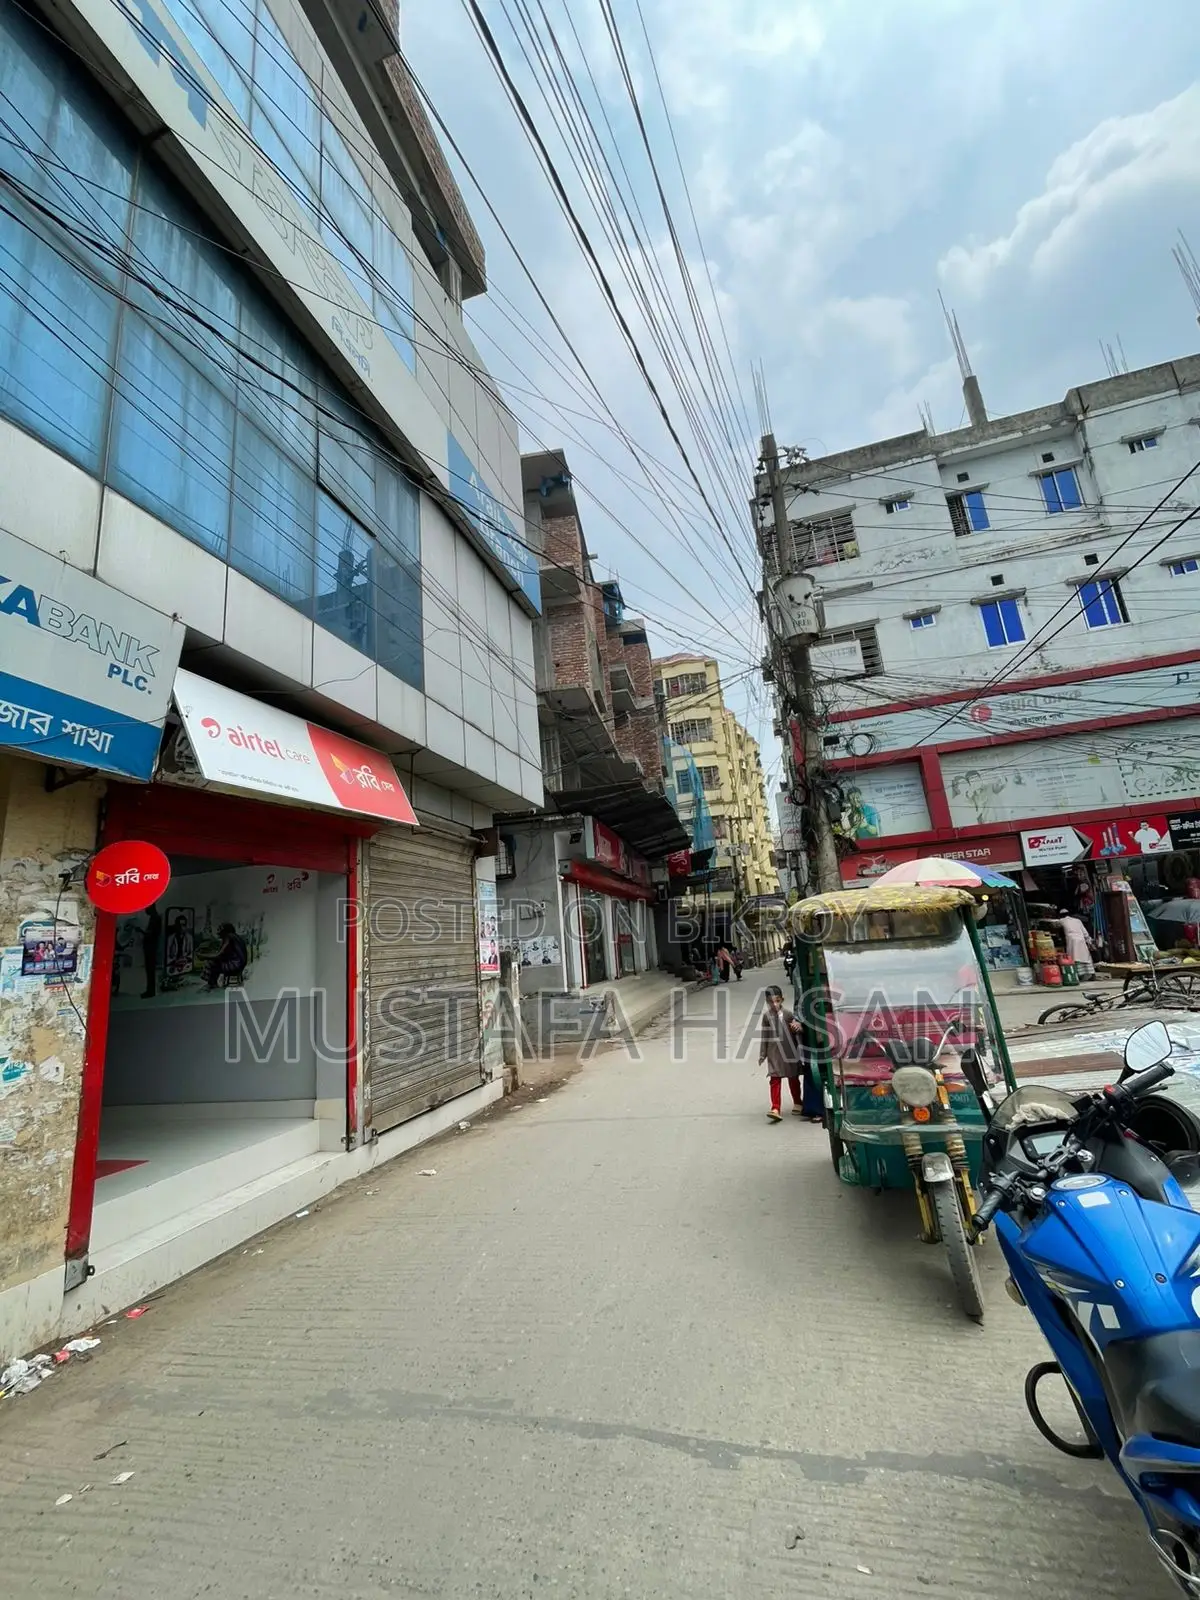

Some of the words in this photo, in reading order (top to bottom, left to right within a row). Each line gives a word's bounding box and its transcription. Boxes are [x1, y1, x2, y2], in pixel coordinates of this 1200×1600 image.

[107, 662, 153, 695] PLC.
[62, 719, 114, 754] শাখা
[227, 725, 285, 760] airtel
[285, 748, 311, 765] care
[352, 764, 383, 793] রবি
[965, 848, 991, 857] STAR
[114, 867, 140, 887] রবি
